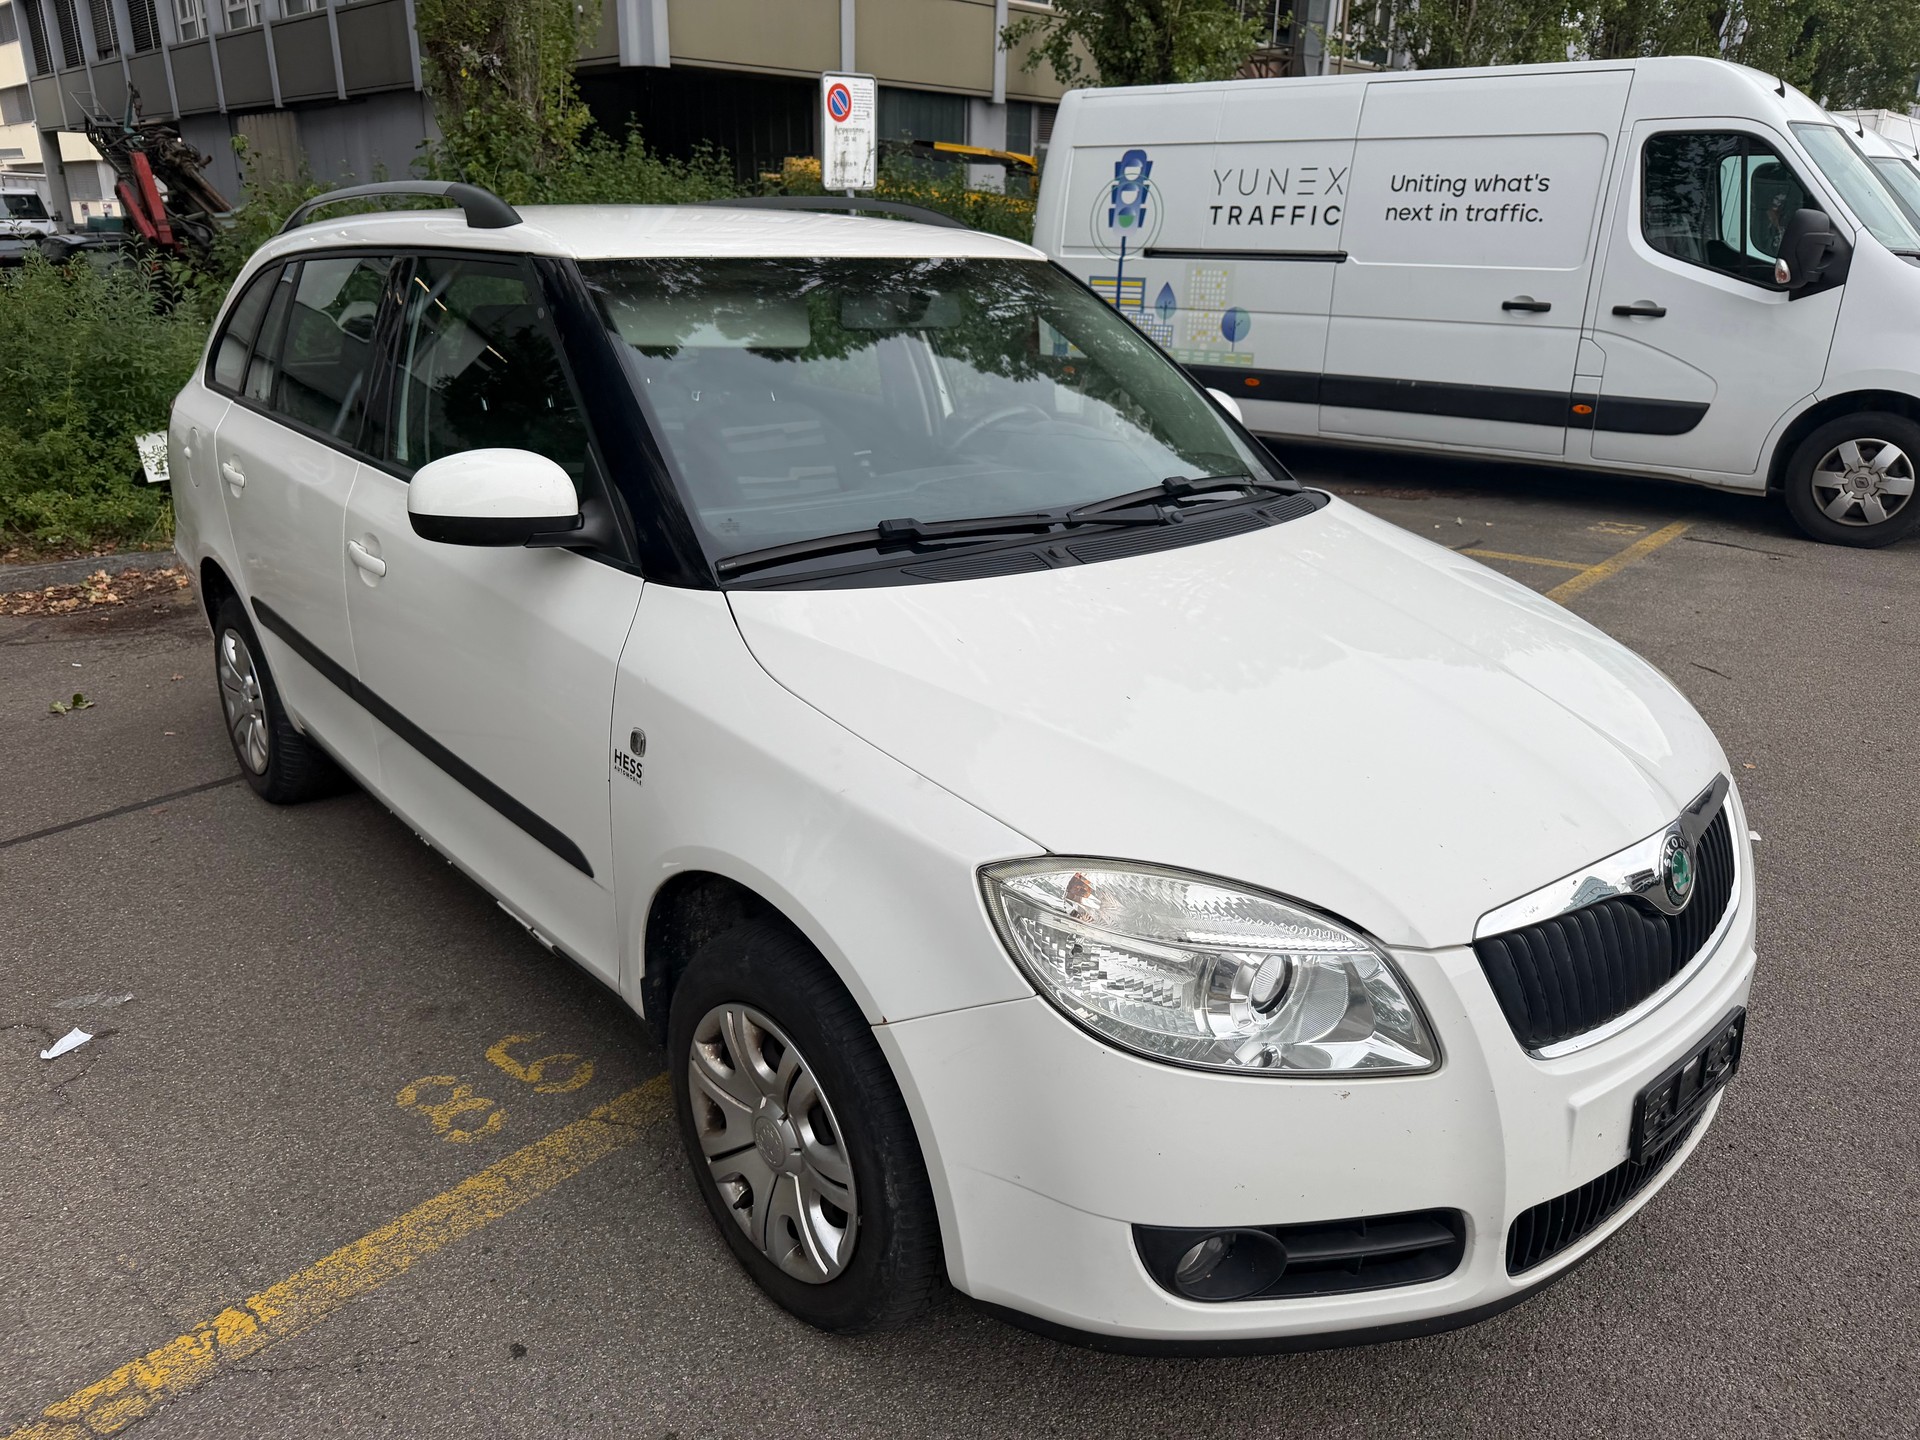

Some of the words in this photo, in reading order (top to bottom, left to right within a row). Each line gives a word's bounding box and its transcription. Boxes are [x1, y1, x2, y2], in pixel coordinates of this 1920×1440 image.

[1213, 166, 1348, 196] YUNEX
[1390, 174, 1467, 198] Uniting
[1474, 173, 1551, 193] what's
[1209, 205, 1341, 226] TRAFFIC
[1385, 206, 1433, 222] next
[1439, 203, 1458, 222] in
[1465, 203, 1544, 223] traffic.
[614, 748, 643, 779] HESS
